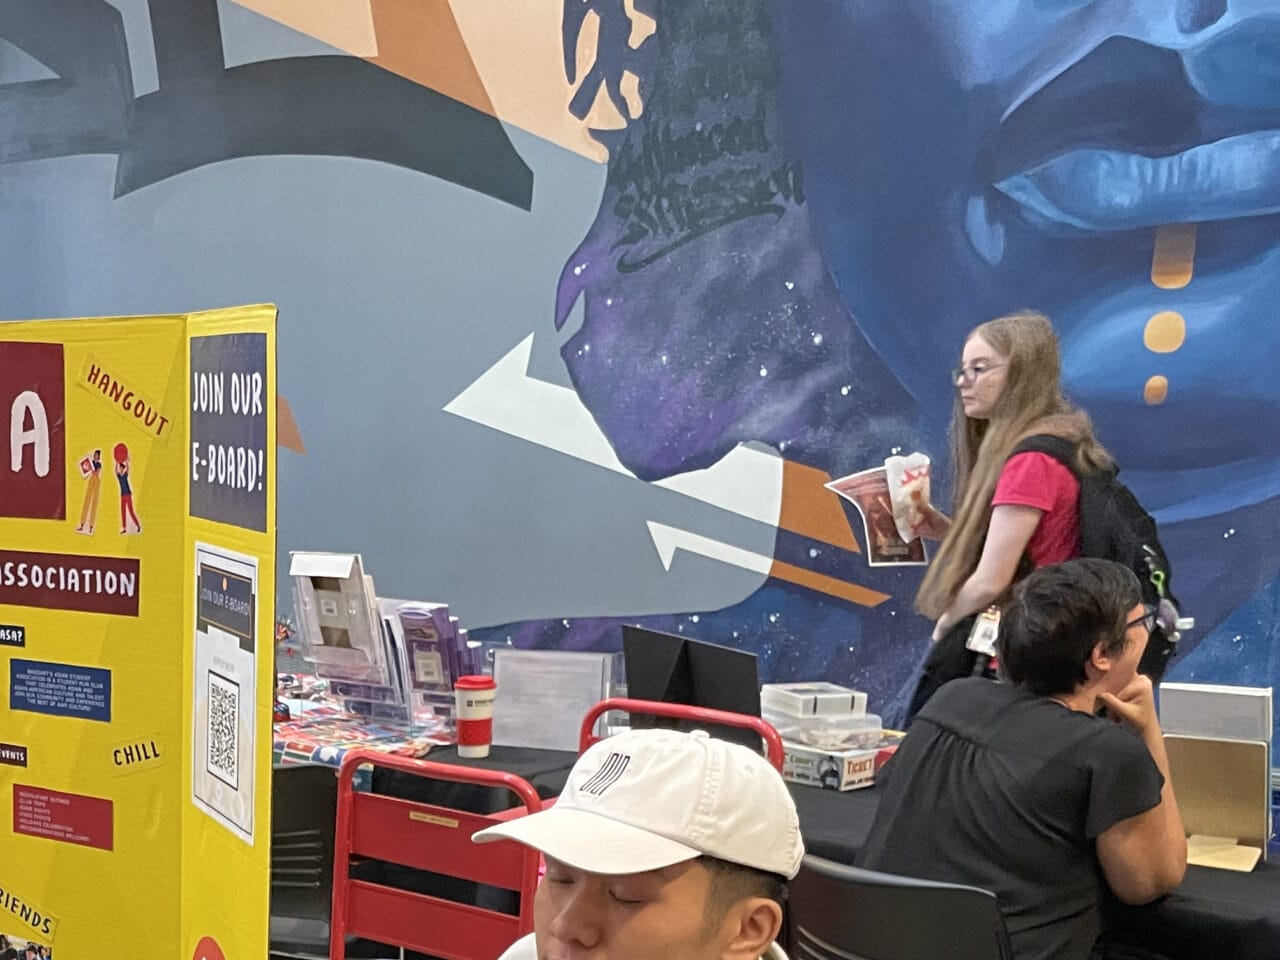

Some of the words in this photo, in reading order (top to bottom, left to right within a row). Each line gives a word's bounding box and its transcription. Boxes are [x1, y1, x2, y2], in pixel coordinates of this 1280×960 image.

[87, 364, 169, 436] HANGOUT
[193, 372, 224, 416] JOIN
[230, 372, 262, 416] OUR
[192, 442, 264, 492] E-BOARD!
[0, 629, 23, 642] ASA?
[114, 741, 160, 766] CHILL
[846, 758, 872, 775] TICKET
